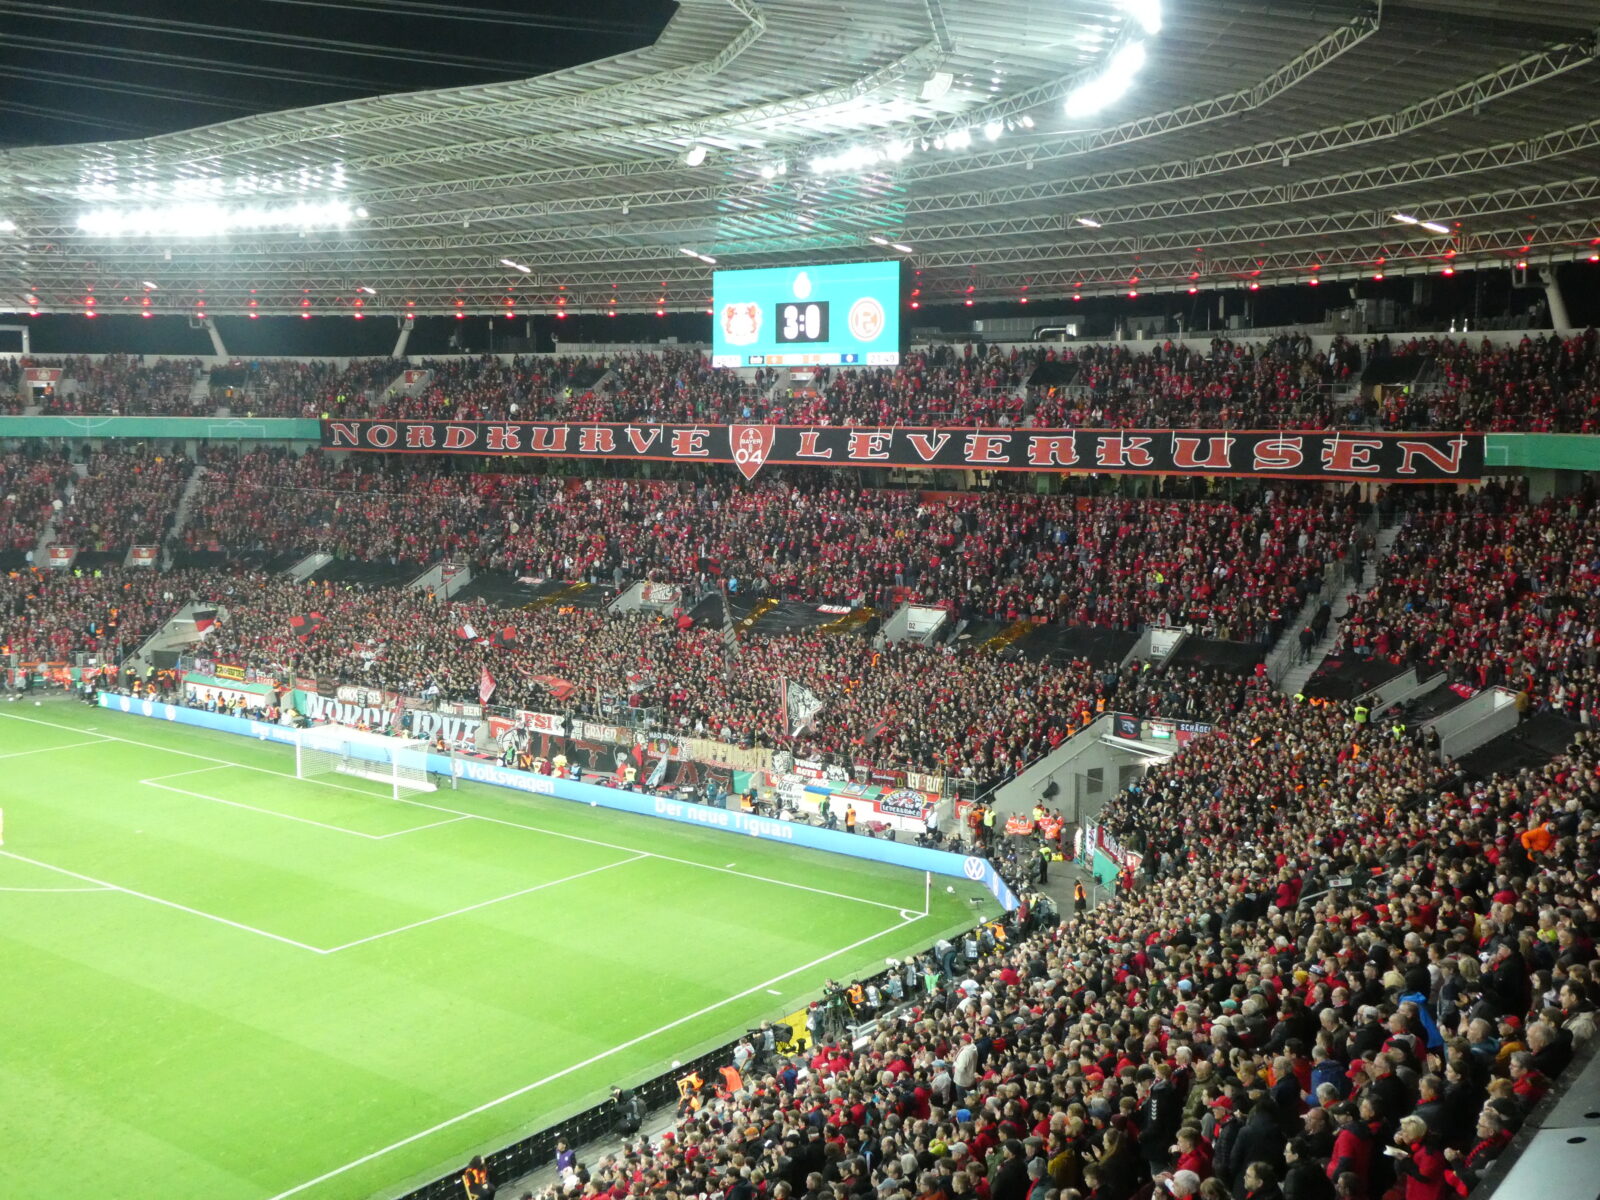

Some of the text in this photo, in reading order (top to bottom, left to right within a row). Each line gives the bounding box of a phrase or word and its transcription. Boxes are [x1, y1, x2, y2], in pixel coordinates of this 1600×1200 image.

[783, 304, 820, 340] 3:0
[330, 422, 710, 457] NORDKURVE
[736, 448, 763, 465] 04
[796, 431, 1468, 475] LEVERKUSEN
[467, 761, 555, 793] Volkswagen
[655, 796, 793, 839] Der neue Tiguan
